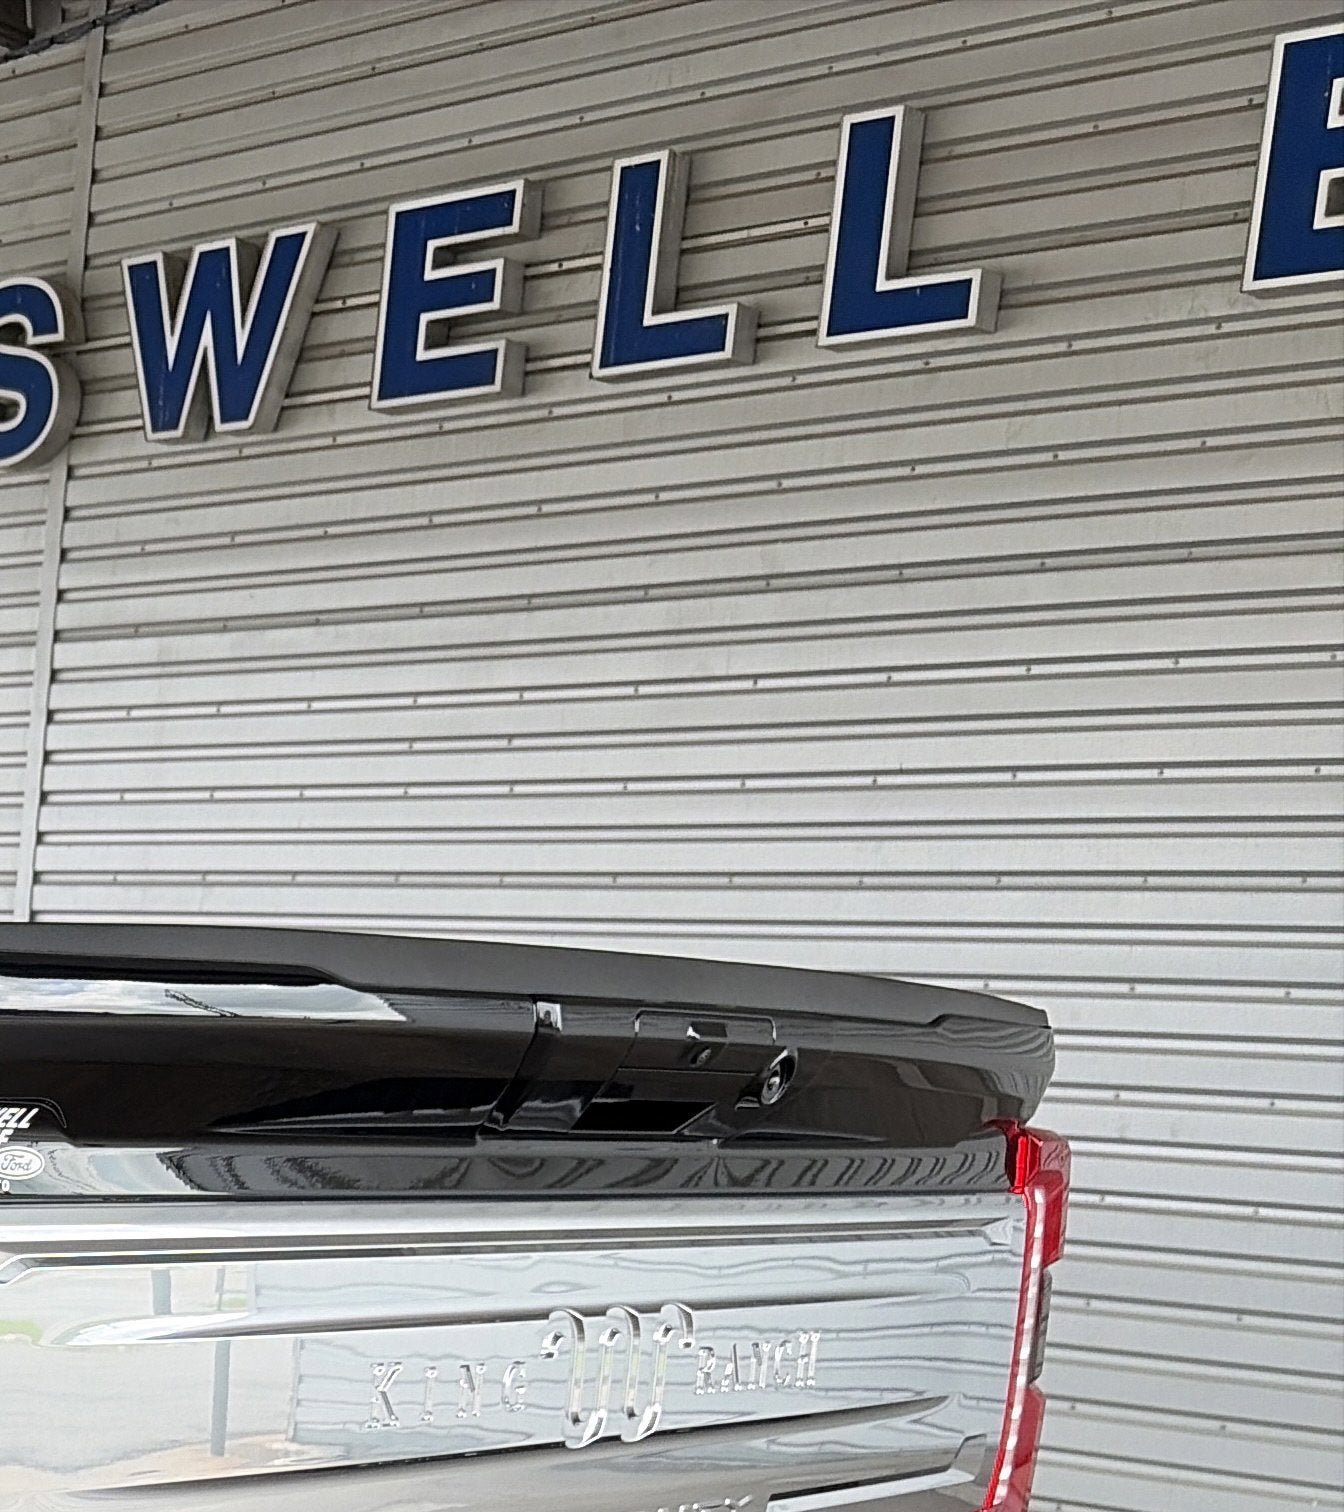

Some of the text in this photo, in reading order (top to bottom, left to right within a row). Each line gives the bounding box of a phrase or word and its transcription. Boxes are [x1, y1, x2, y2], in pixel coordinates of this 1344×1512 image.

[0, 1153, 33, 1173] Ford
[365, 1330, 821, 1430] KING RANCH
